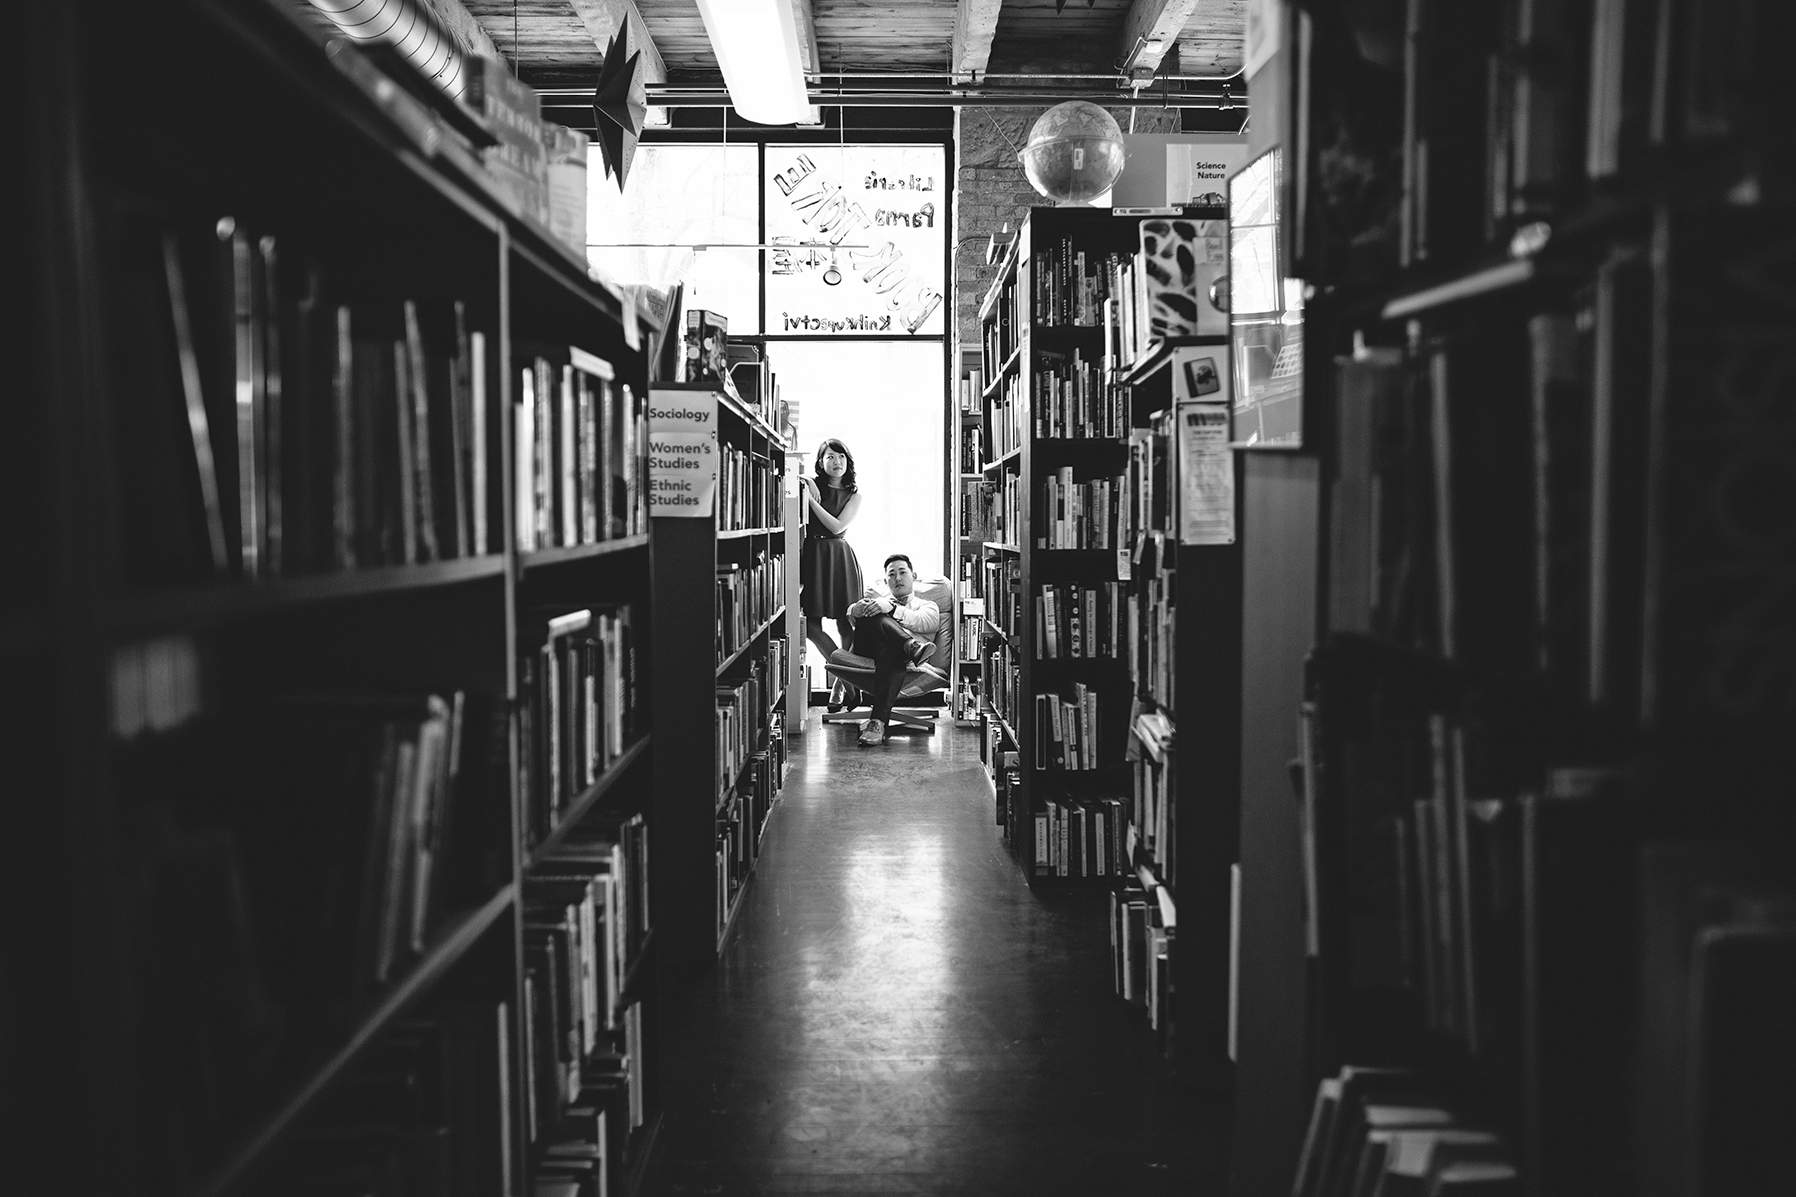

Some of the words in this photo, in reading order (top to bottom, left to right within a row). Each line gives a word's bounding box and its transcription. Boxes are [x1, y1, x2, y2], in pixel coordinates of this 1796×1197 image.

[1196, 161, 1226, 170] Science
[1197, 171, 1225, 180] Nature
[649, 408, 710, 423] Sociology
[649, 442, 711, 455] Women's
[649, 457, 700, 470] Studies
[649, 479, 692, 492] Ethnic
[649, 494, 700, 506] Studies
